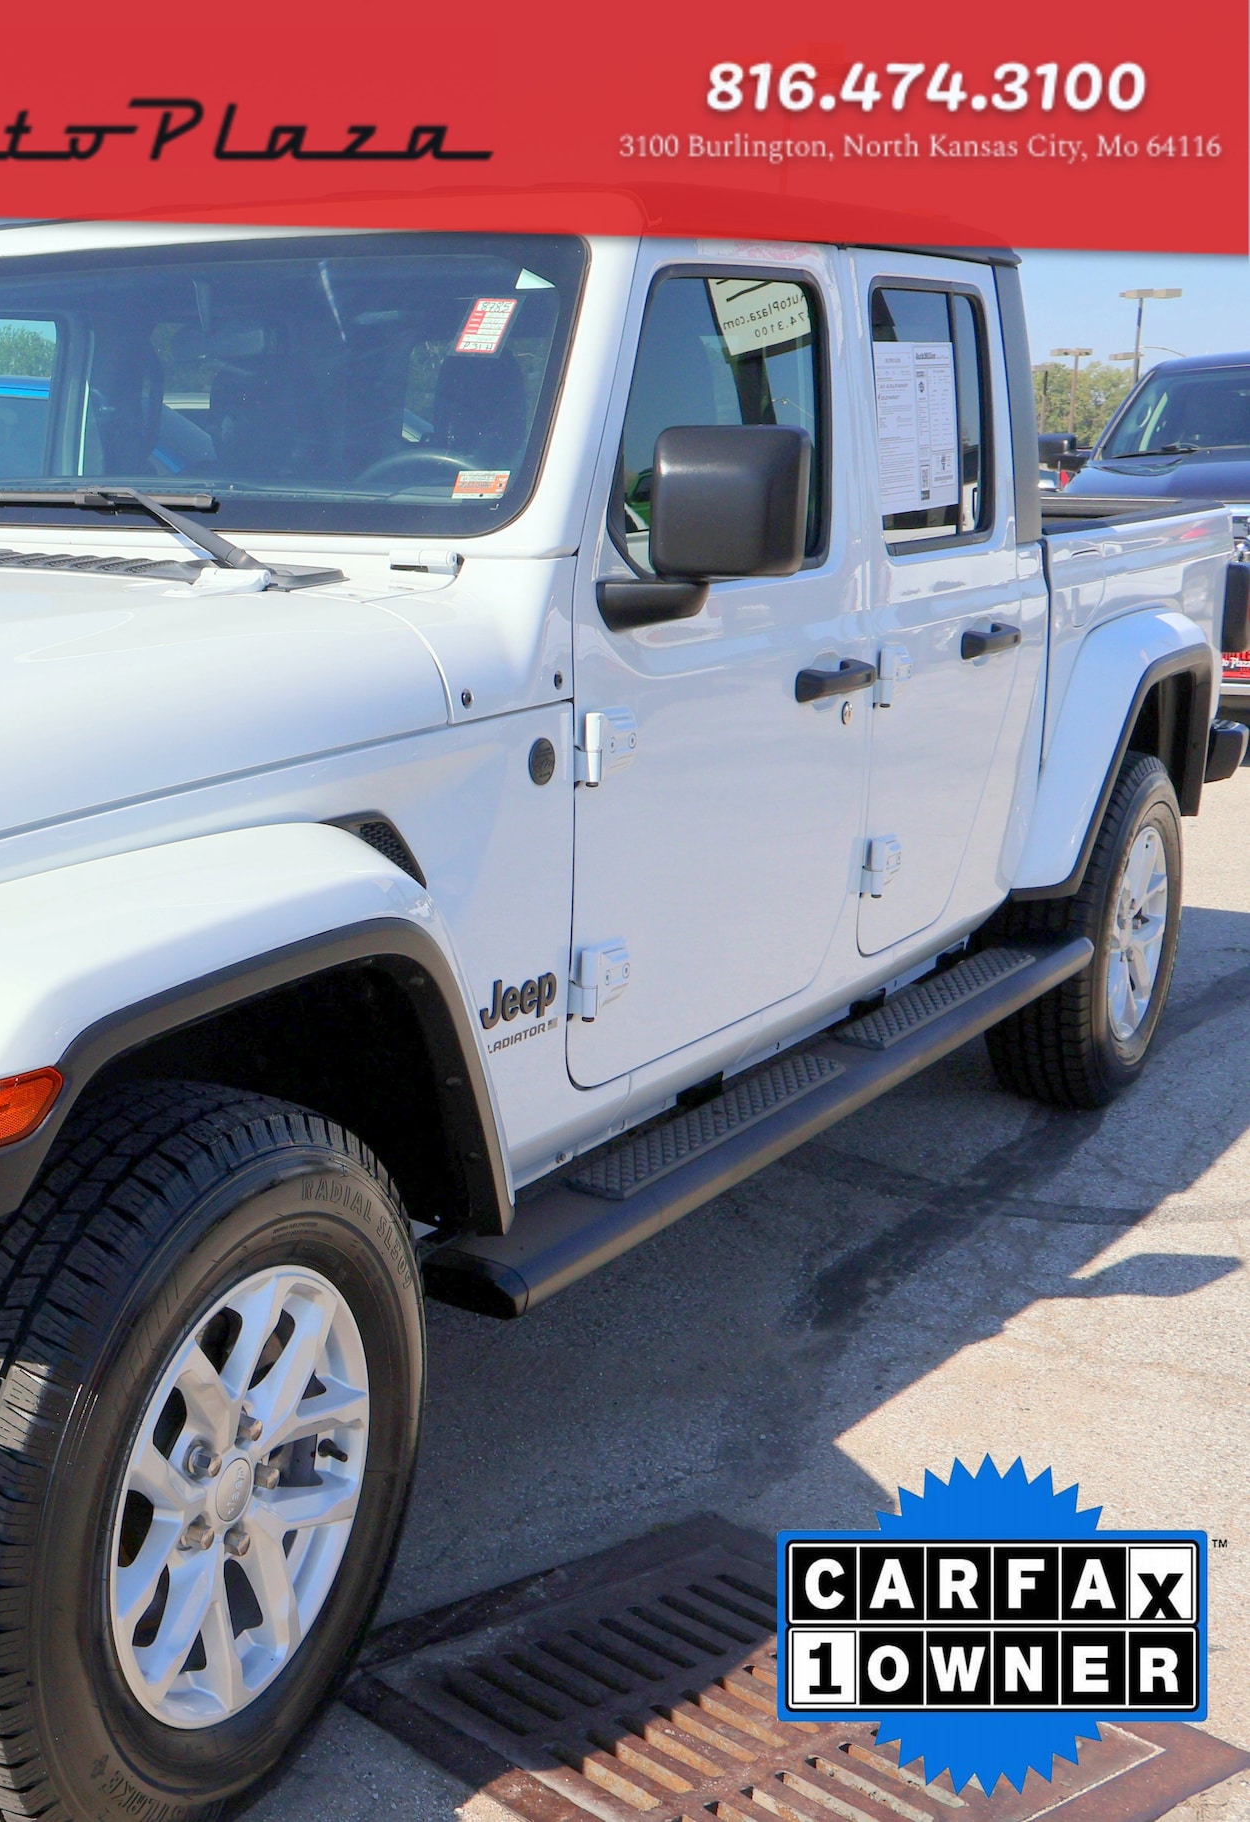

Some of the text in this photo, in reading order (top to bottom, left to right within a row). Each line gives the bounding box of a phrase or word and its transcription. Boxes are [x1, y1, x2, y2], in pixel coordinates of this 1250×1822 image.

[479, 971, 557, 1030] Jeep
[487, 1022, 546, 1054] LADIATOR
[301, 1178, 413, 1291] RADIAL SL309
